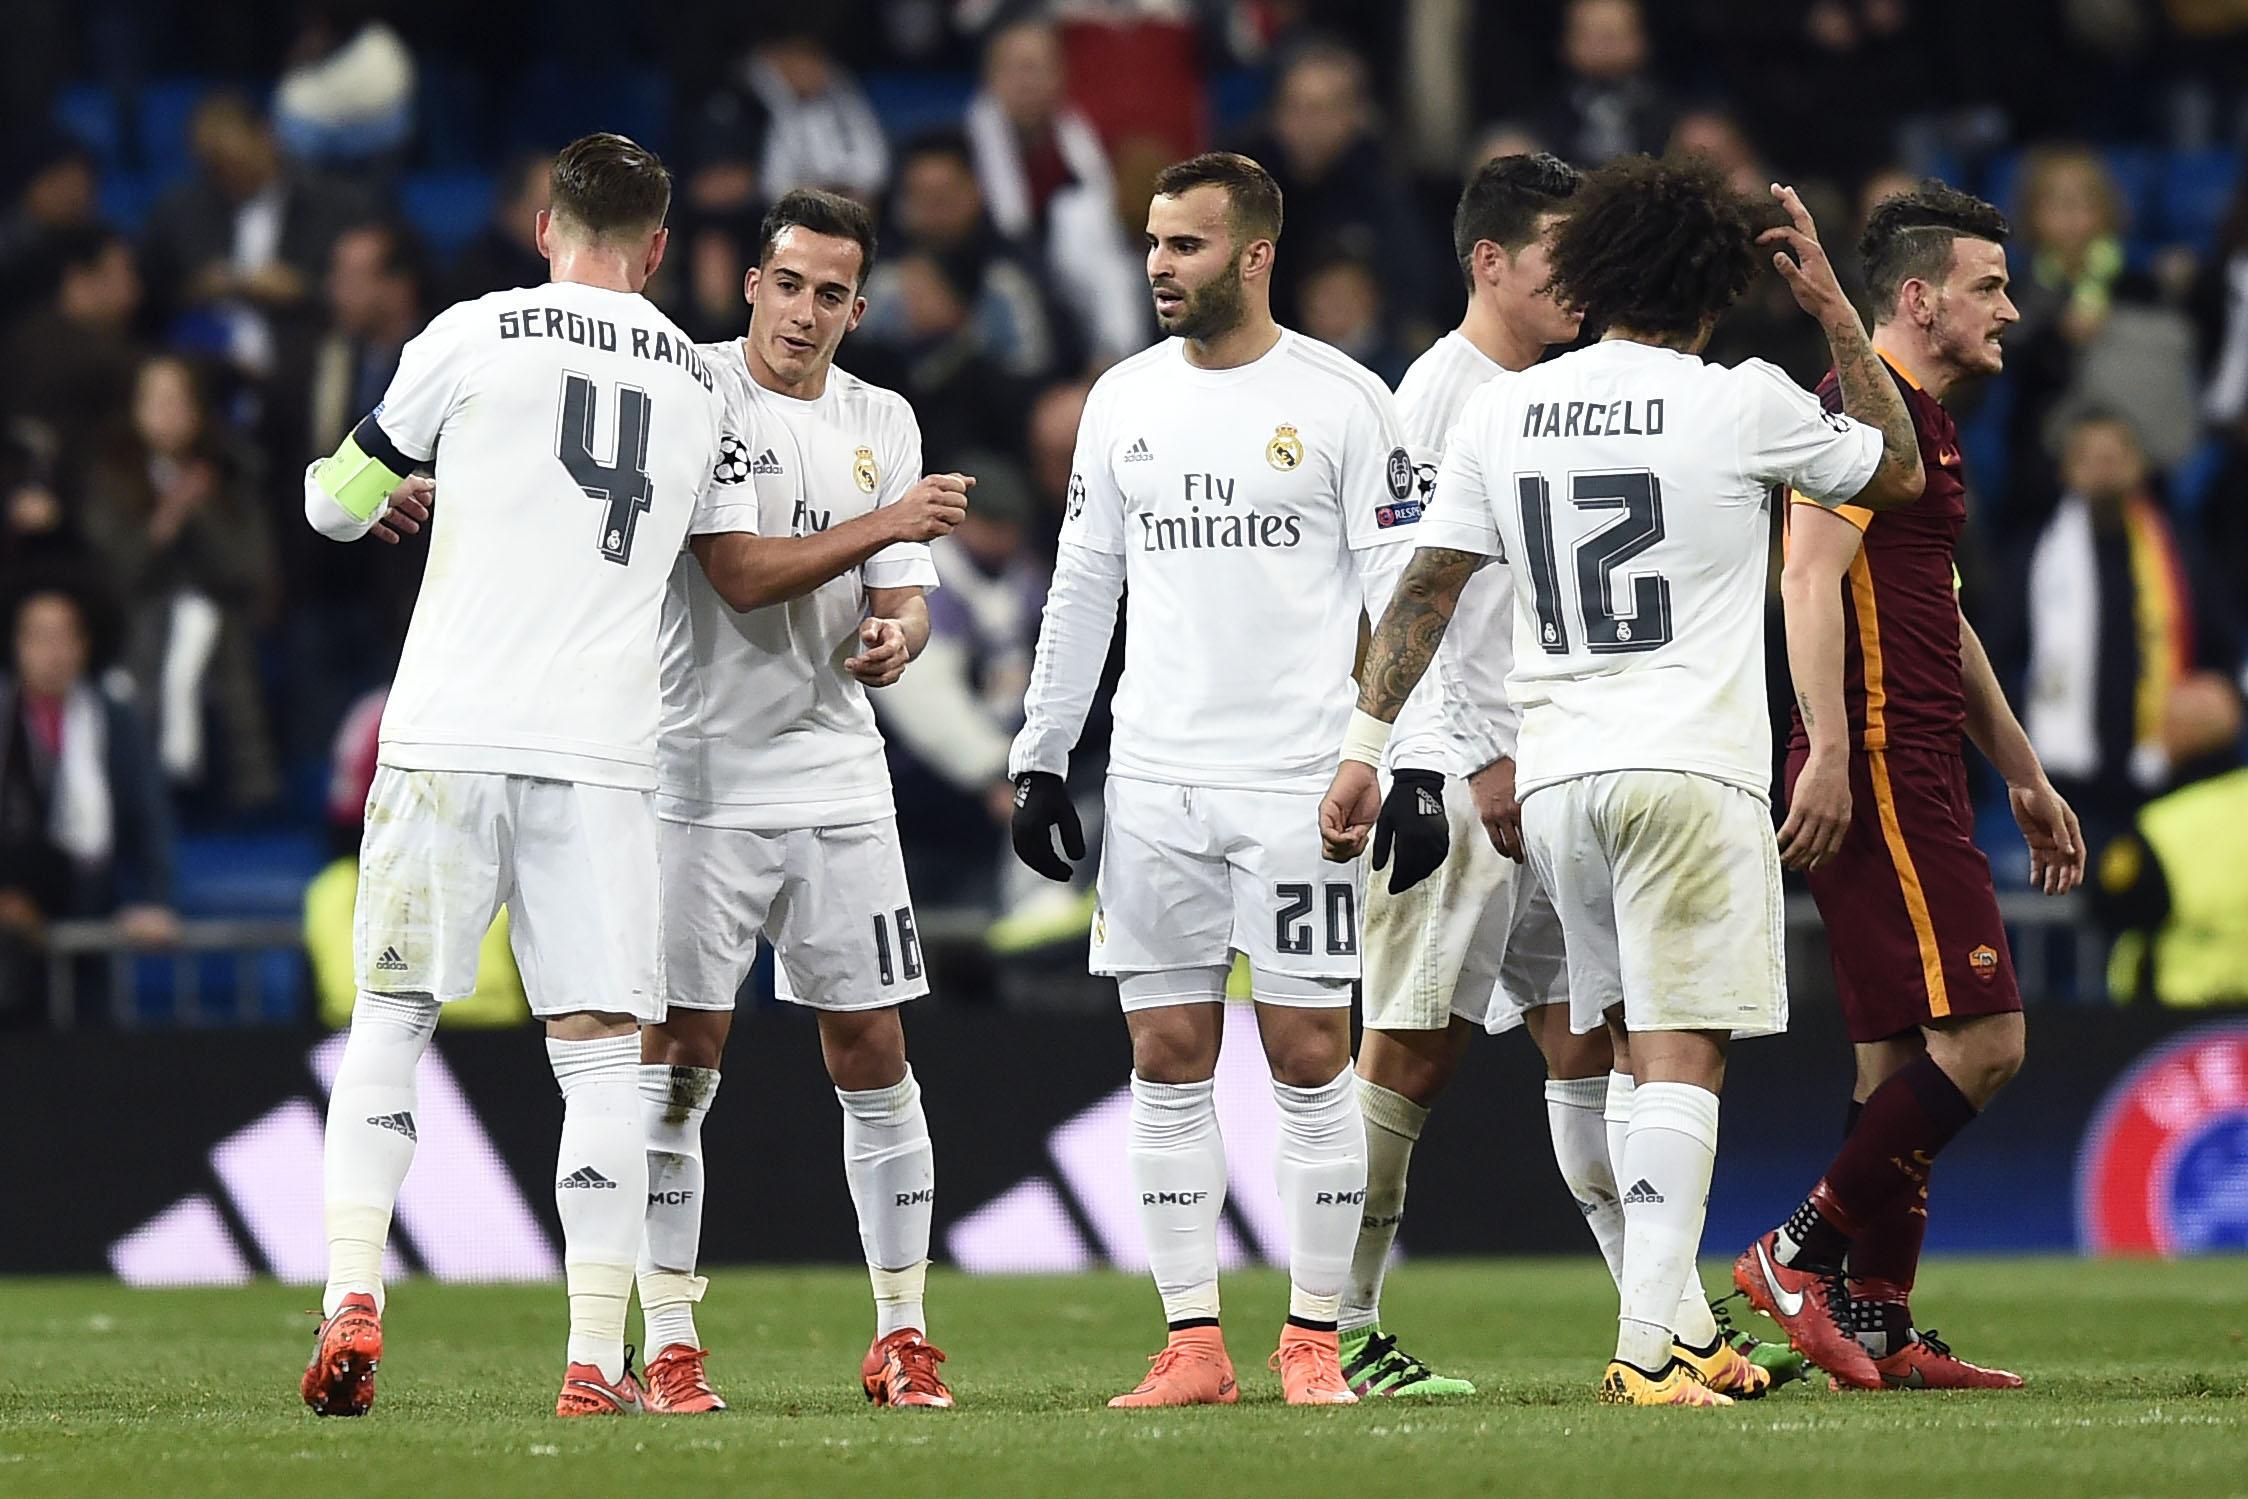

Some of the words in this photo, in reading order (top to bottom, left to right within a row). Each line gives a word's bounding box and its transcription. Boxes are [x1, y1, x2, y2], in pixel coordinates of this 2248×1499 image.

[499, 307, 617, 352] SERGIO
[1523, 399, 1664, 437] MARCELO
[554, 369, 653, 566] 4
[1124, 453, 1154, 463] adidas
[1184, 473, 1235, 506] Fly
[1395, 506, 1421, 519] RESPE
[1139, 505, 1301, 552] Emirates
[1514, 467, 1674, 655] 12
[1274, 880, 1357, 956] 20
[376, 960, 408, 970] adidas
[366, 1116, 418, 1145] adida
[557, 1180, 617, 1189] adidas
[648, 1191, 694, 1205] MCF
[896, 1188, 933, 1207] RMC
[1142, 1191, 1208, 1206] RMCF
[1599, 1391, 1634, 1404] didas
